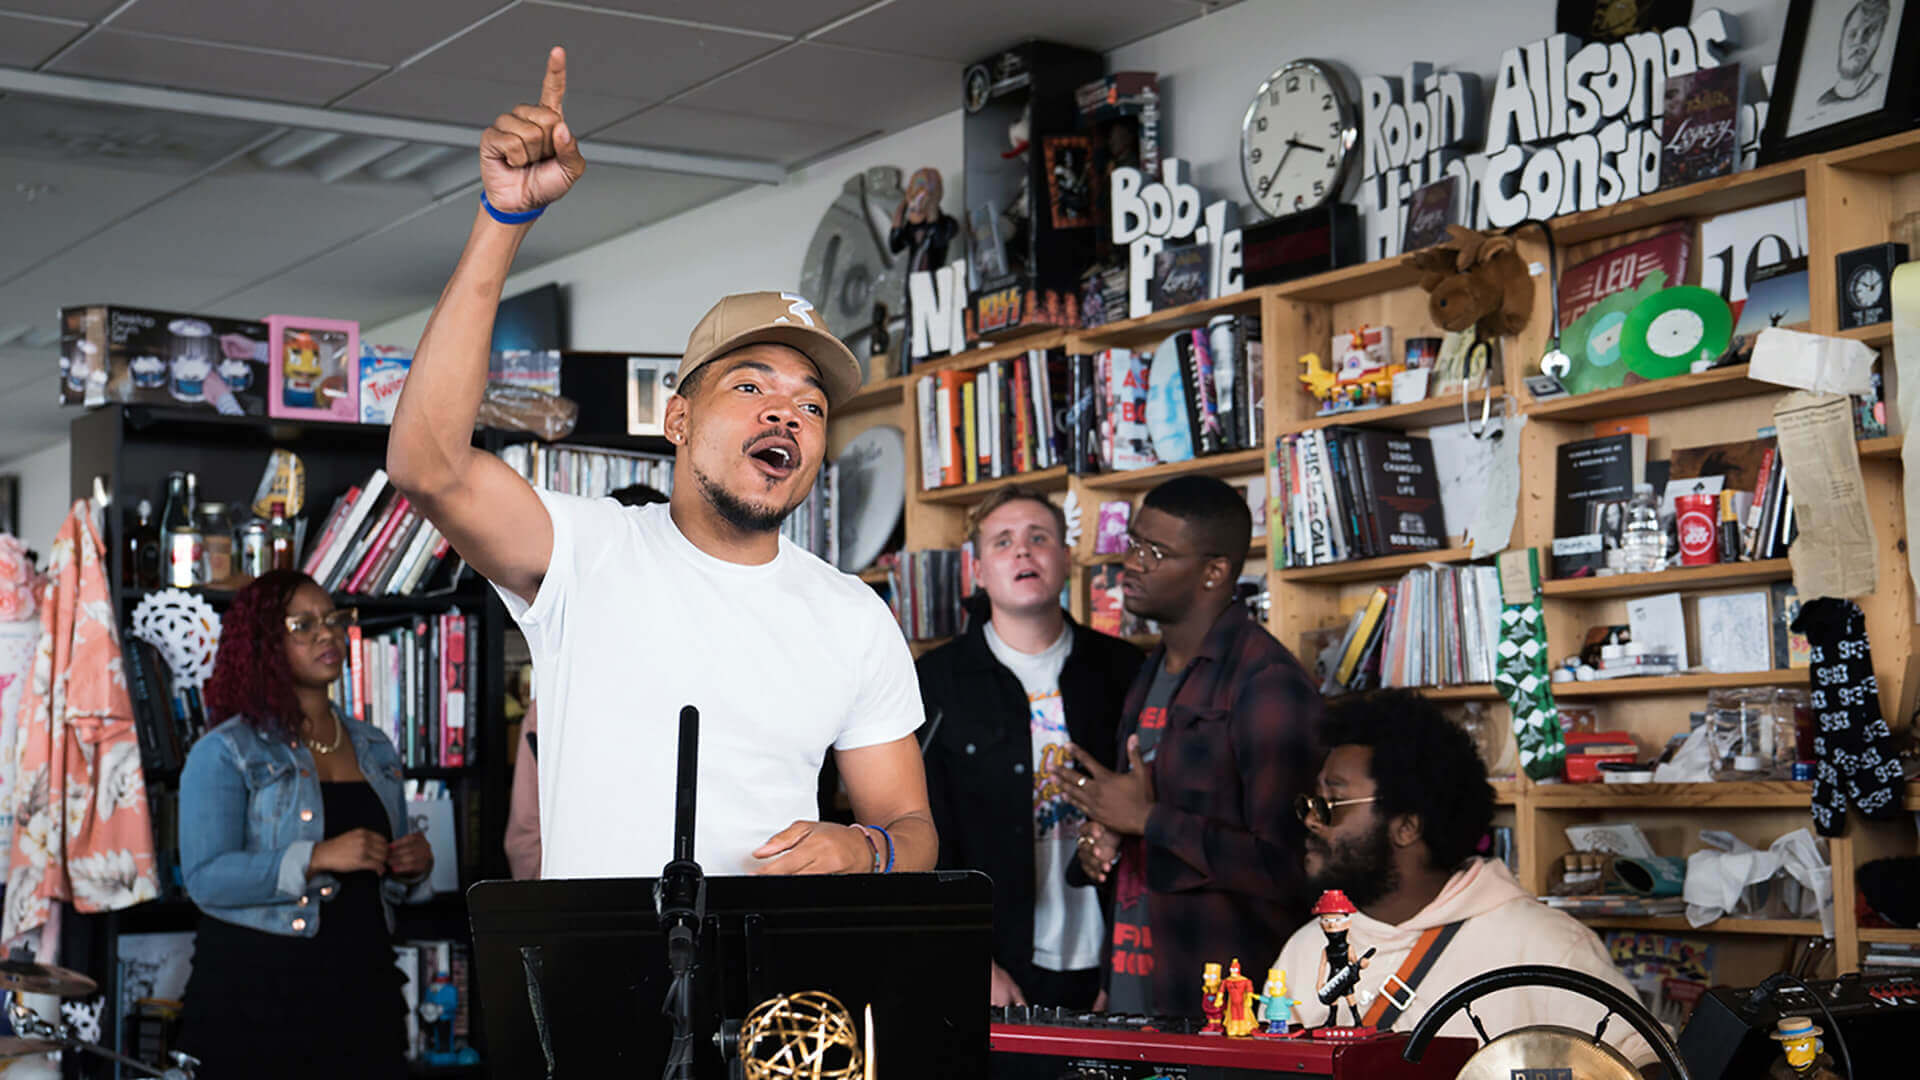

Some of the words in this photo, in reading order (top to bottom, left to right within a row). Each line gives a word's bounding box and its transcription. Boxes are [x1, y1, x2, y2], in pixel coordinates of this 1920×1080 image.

[1361, 62, 1464, 183] Robin
[1111, 157, 1200, 246] Bob
[978, 288, 1023, 333] KISS
[1310, 517, 1326, 560] CALL
